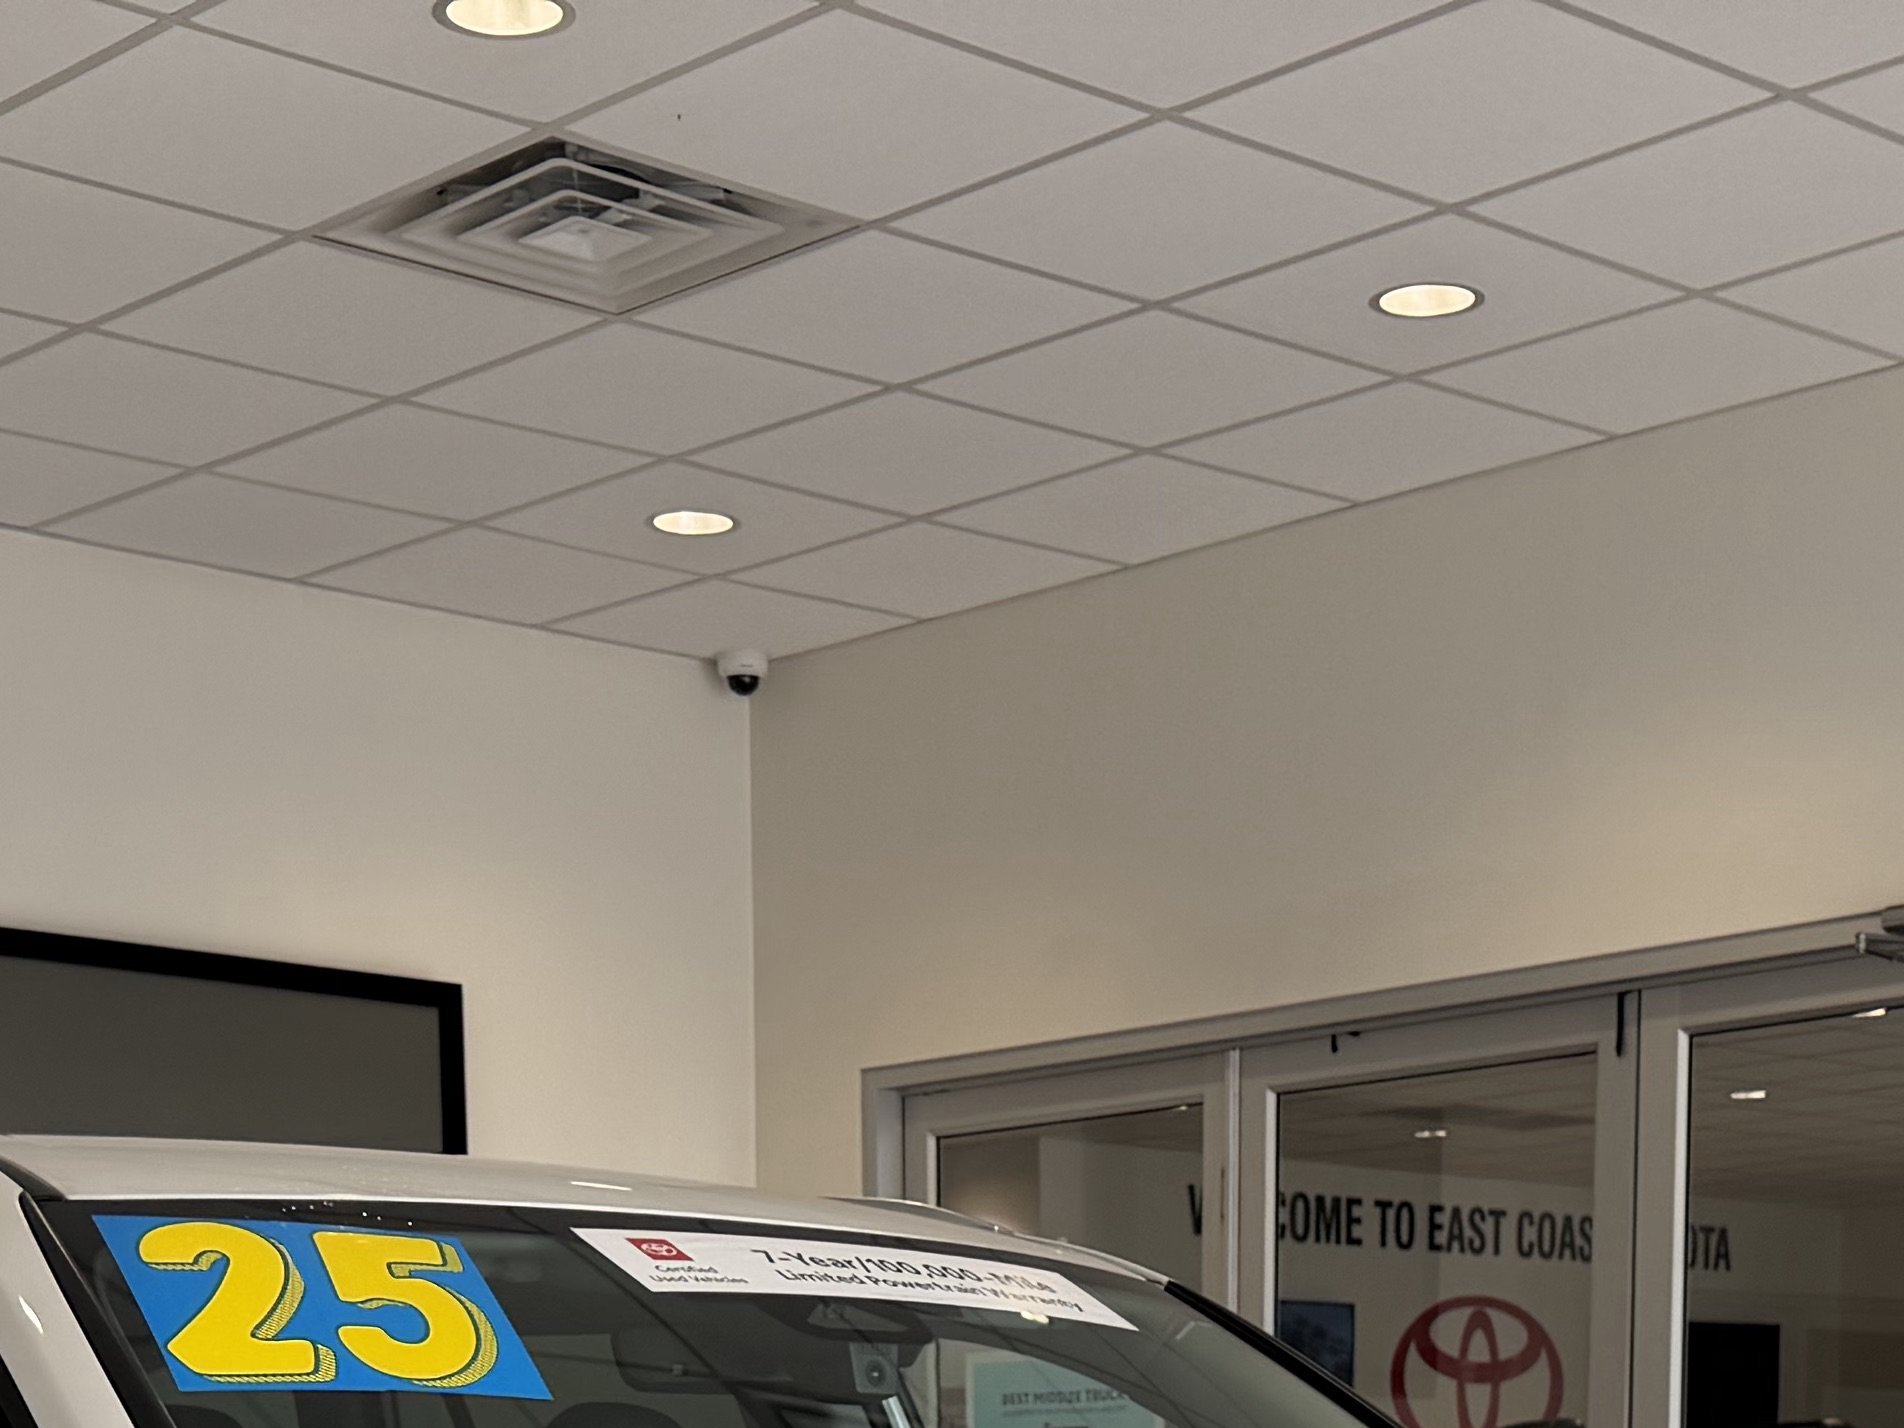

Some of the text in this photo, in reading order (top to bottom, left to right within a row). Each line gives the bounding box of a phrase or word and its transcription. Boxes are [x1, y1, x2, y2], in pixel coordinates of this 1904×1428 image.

[1374, 1200, 1415, 1251] TO
[1427, 1205, 1507, 1256] EAST
[1517, 1211, 1593, 1263] COAS
[138, 1221, 498, 1387] 25
[775, 1269, 865, 1285] Limited
[871, 1276, 984, 1296] Powertrain
